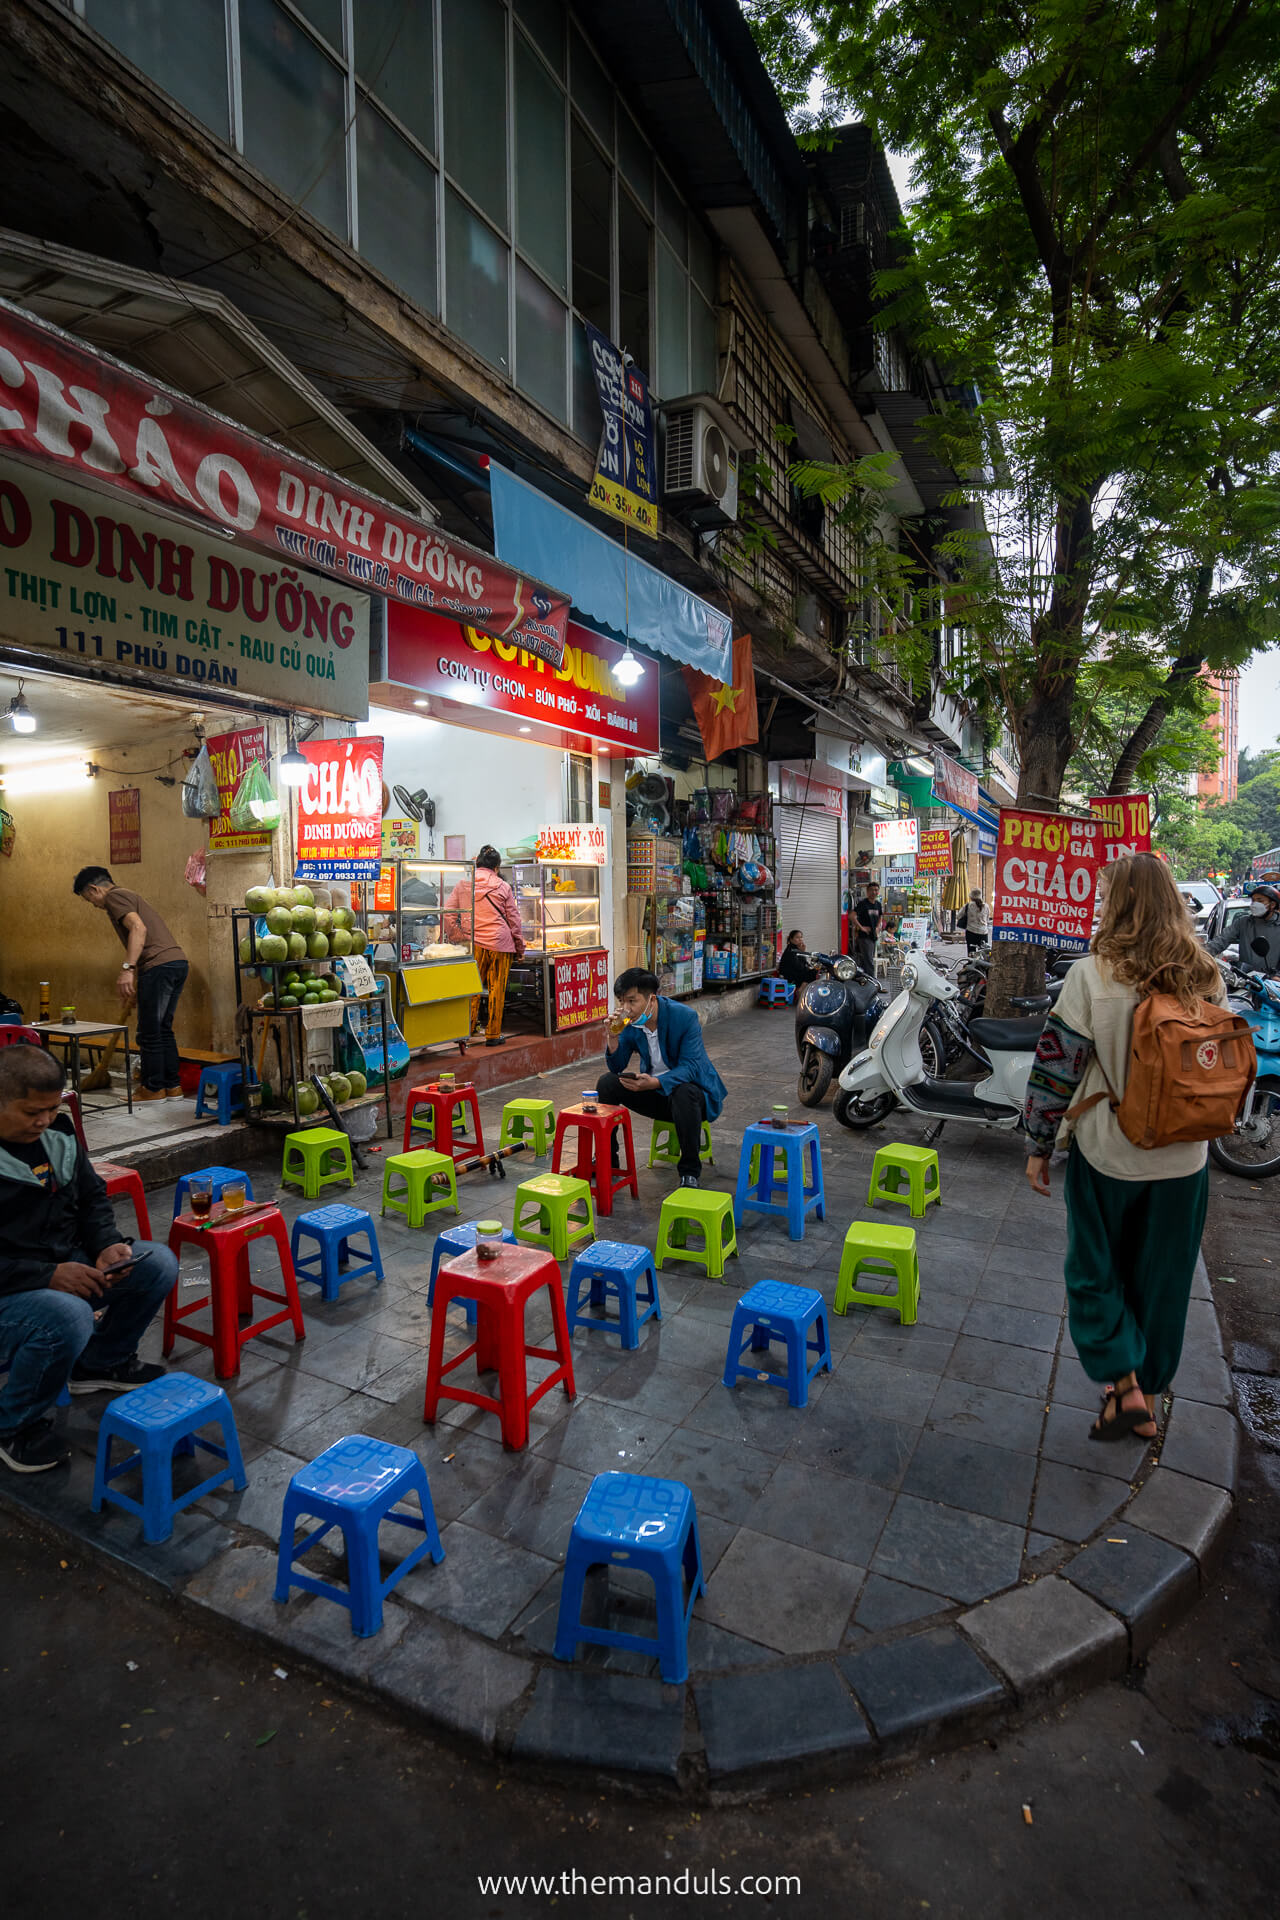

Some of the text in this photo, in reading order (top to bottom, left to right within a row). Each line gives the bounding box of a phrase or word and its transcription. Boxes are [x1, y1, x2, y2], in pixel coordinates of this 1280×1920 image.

[276, 470, 484, 600] DINH DƯỠNG
[50, 499, 195, 602] DINH
[206, 556, 356, 650] DƯỠNG
[275, 525, 308, 557] THỊT
[309, 537, 336, 569] LỢN
[346, 551, 374, 586] THỊT
[374, 560, 390, 590] BÒ
[396, 574, 415, 605] TIM
[4, 567, 63, 614] THỊT
[70, 586, 117, 625] LỢN
[139, 606, 179, 640] TIM
[185, 619, 223, 654] CẬT
[240, 634, 275, 665] RAU
[280, 640, 301, 672] CỦ
[305, 651, 336, 681] QUẢ
[55, 627, 239, 687] 111 PHỦ DOÃN
[526, 634, 540, 651] 097
[438, 657, 469, 682] CƠM
[472, 667, 491, 692] TỰ
[492, 675, 525, 700] CHỌN
[535, 688, 555, 708] BÚN
[557, 695, 577, 714] PHỞ
[585, 703, 601, 721] XÔI
[607, 710, 628, 730] BÁNH
[301, 743, 380, 815] CHÁO
[304, 818, 375, 840] DINH DƯỠNG
[1003, 817, 1063, 852] PHỞ
[1128, 801, 1149, 837] TO
[541, 826, 566, 848] BÁNH
[588, 827, 605, 847] XÔI
[1070, 839, 1095, 858] GÀ
[319, 872, 334, 880] 097
[335, 872, 356, 880] 9933
[334, 860, 351, 870] PHỦ
[1003, 854, 1091, 902] CHÁO
[1001, 895, 1088, 919] DINH DƯỠNG
[999, 930, 1019, 941] ĐC:
[1022, 932, 1039, 943] 111
[1041, 934, 1058, 947] PHỦ
[1002, 912, 1036, 926] RAU
[1057, 919, 1085, 936] QUẢ
[576, 955, 590, 981] PHỞ
[597, 957, 607, 977] GÀ
[559, 985, 574, 1011] BÚN
[598, 980, 607, 1001] BÒ
